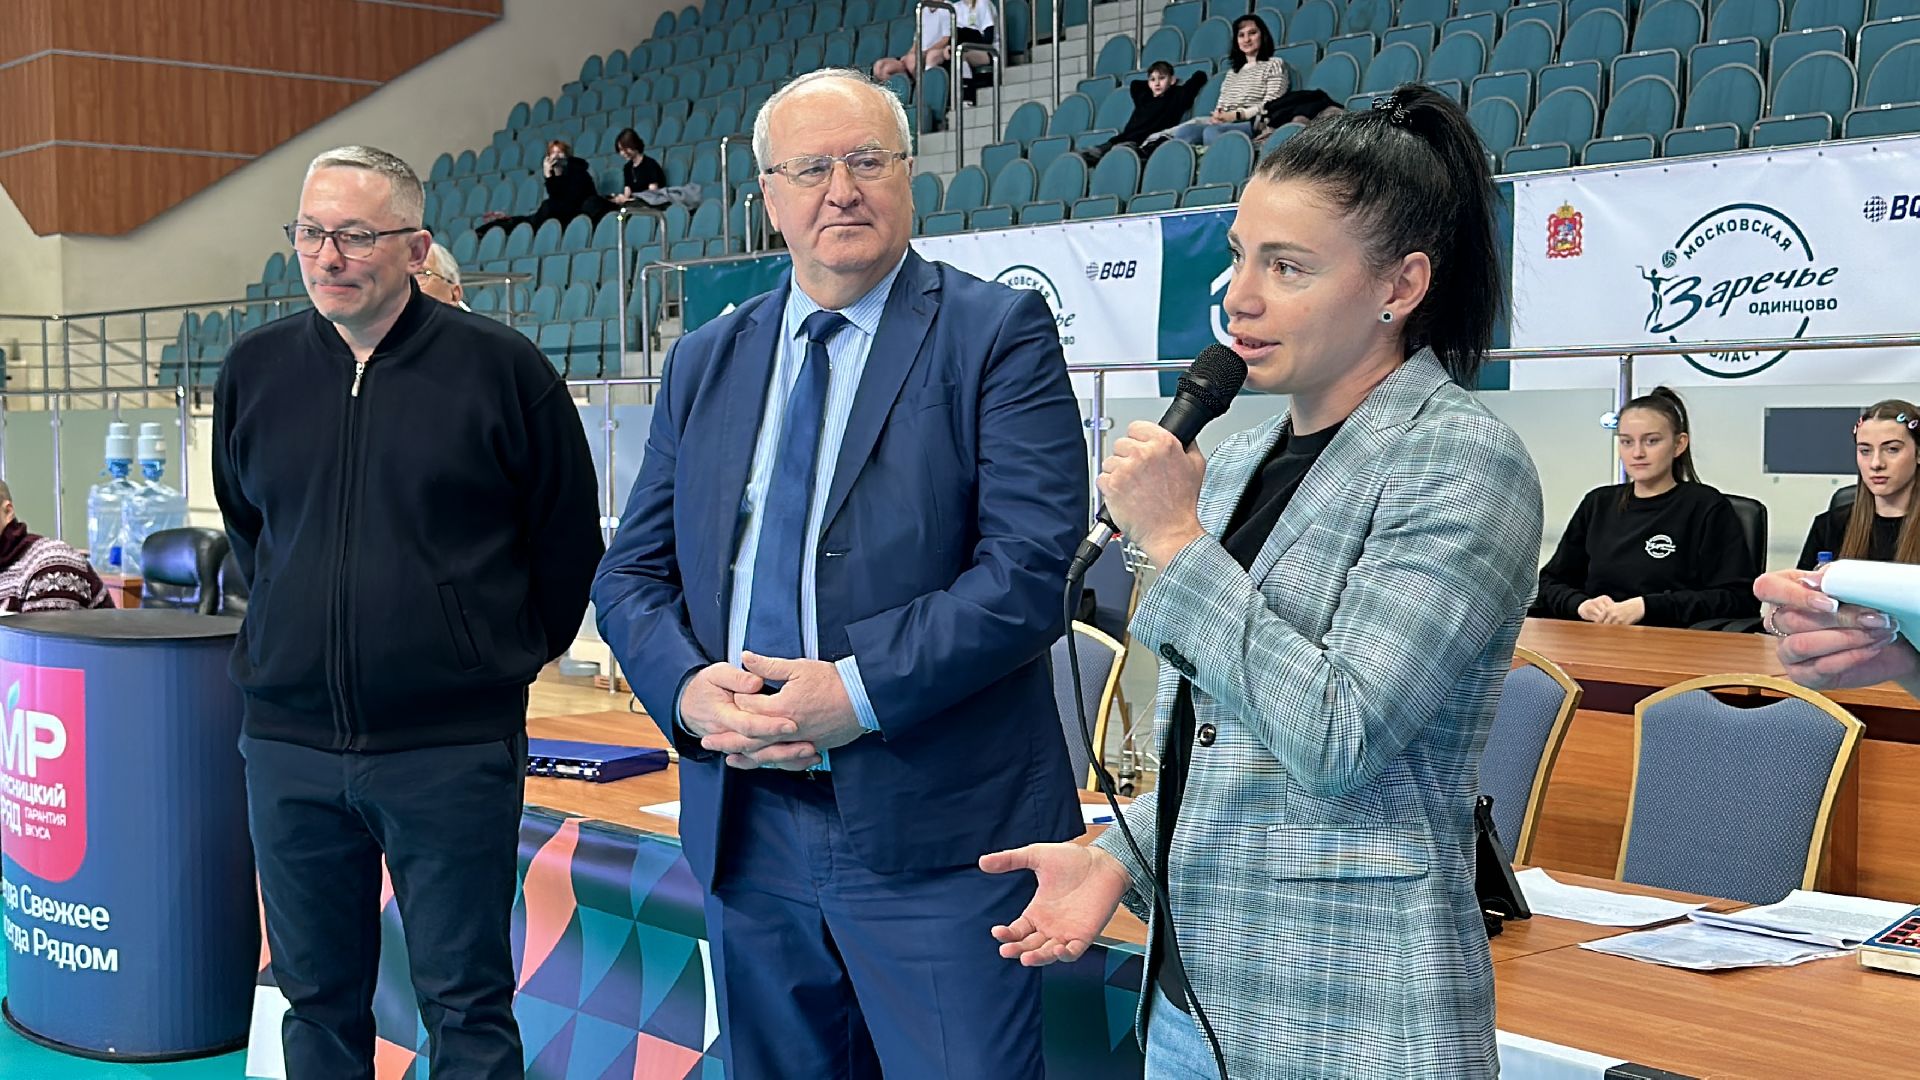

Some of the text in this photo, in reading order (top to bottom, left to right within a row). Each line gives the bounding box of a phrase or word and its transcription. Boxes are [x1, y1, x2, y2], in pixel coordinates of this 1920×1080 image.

[1683, 218, 1793, 259] МОСКОВСКАЯ
[1099, 260, 1137, 280] ВФВ
[1007, 275, 1051, 299] КОВСКАЯ
[1650, 267, 1839, 334] Заречье
[1749, 298, 1838, 315] ОДИНЦОВО
[24, 806, 67, 827] ГАРАНТИЯ
[25, 823, 51, 840] ВКУСА
[20, 884, 110, 931] Свежее
[33, 927, 118, 972] Рядом
